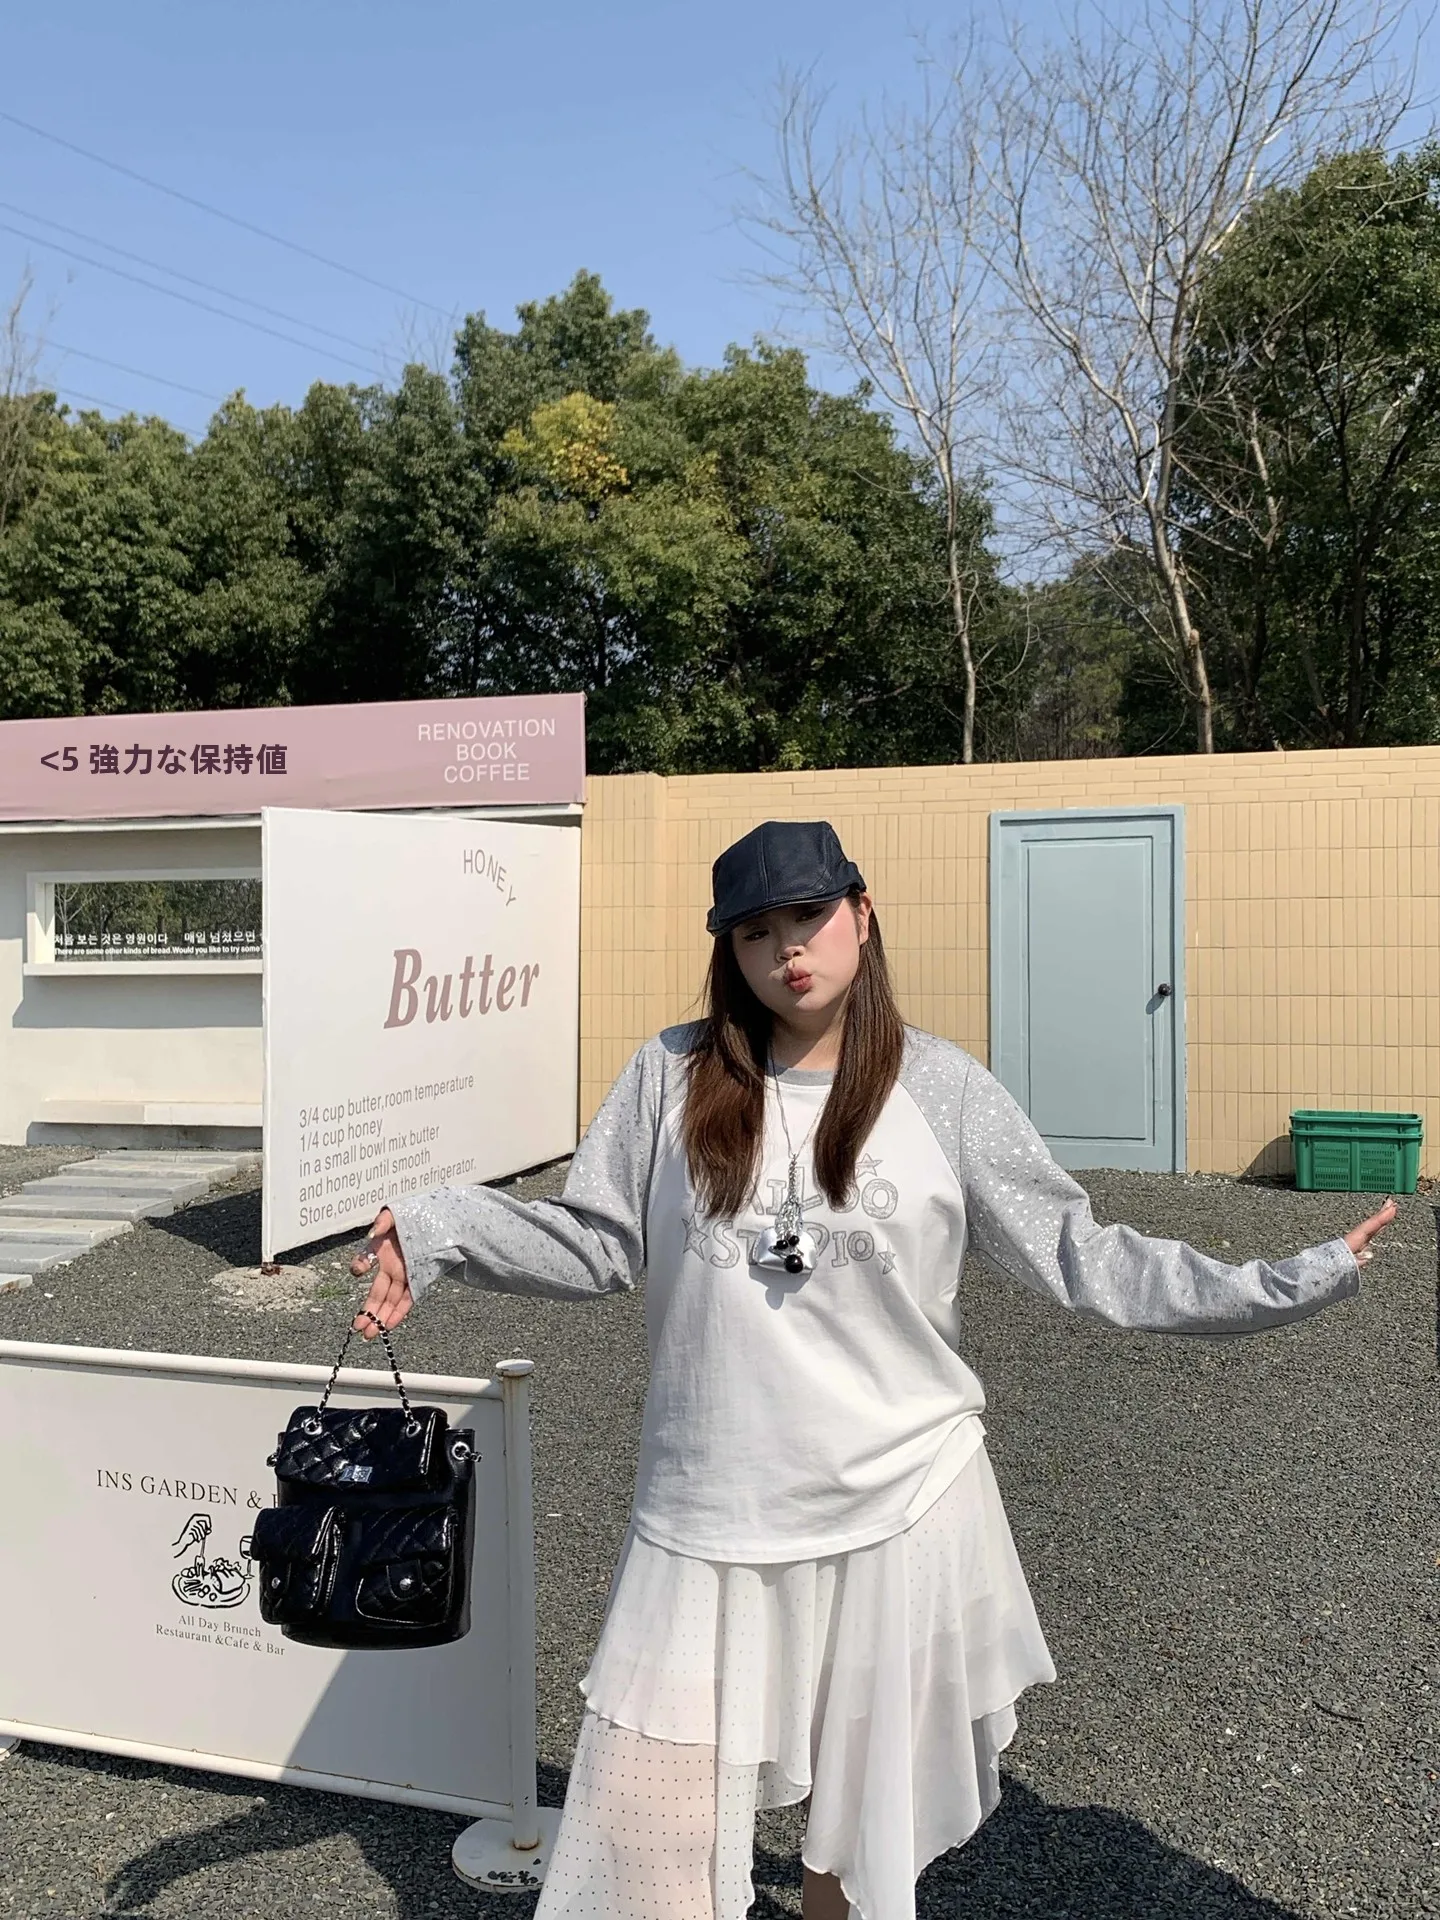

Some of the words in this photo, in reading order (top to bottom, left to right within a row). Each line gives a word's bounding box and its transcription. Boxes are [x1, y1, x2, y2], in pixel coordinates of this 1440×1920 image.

[417, 719, 556, 742] RENOVATION
[89, 743, 288, 775] 強力な保持値
[456, 742, 518, 762] BOOK
[444, 762, 531, 784] COFFEE
[463, 849, 517, 907] HONEY
[123, 947, 142, 955] kinds
[195, 947, 207, 955] you
[231, 946, 240, 954] try
[383, 948, 540, 1029] Butter
[299, 1107, 319, 1128] 3/4
[322, 1105, 344, 1123] cup
[415, 1074, 475, 1100] temperature
[299, 1160, 311, 1178] in
[314, 1160, 322, 1174] a
[325, 1145, 357, 1171] small
[360, 1137, 386, 1161] bowl
[388, 1133, 408, 1152] mix
[409, 1125, 440, 1147] butter
[300, 1131, 319, 1152] 1/4
[322, 1129, 344, 1147] cup
[348, 1119, 383, 1141] honey
[299, 1180, 323, 1202] and
[326, 1171, 363, 1195] honey
[365, 1159, 389, 1181] until
[392, 1147, 431, 1174] smooth
[400, 1176, 416, 1194] the
[419, 1157, 477, 1186] refrigerator.
[97, 1469, 132, 1491] INS
[141, 1475, 239, 1506] GARDEN
[246, 1490, 263, 1509] &
[155, 1624, 212, 1644] Restaurant
[253, 1639, 262, 1652] &
[266, 1642, 286, 1656] Bar
[178, 1615, 195, 1627] All
[199, 1617, 219, 1632] Day
[223, 1621, 262, 1637] Brunch
